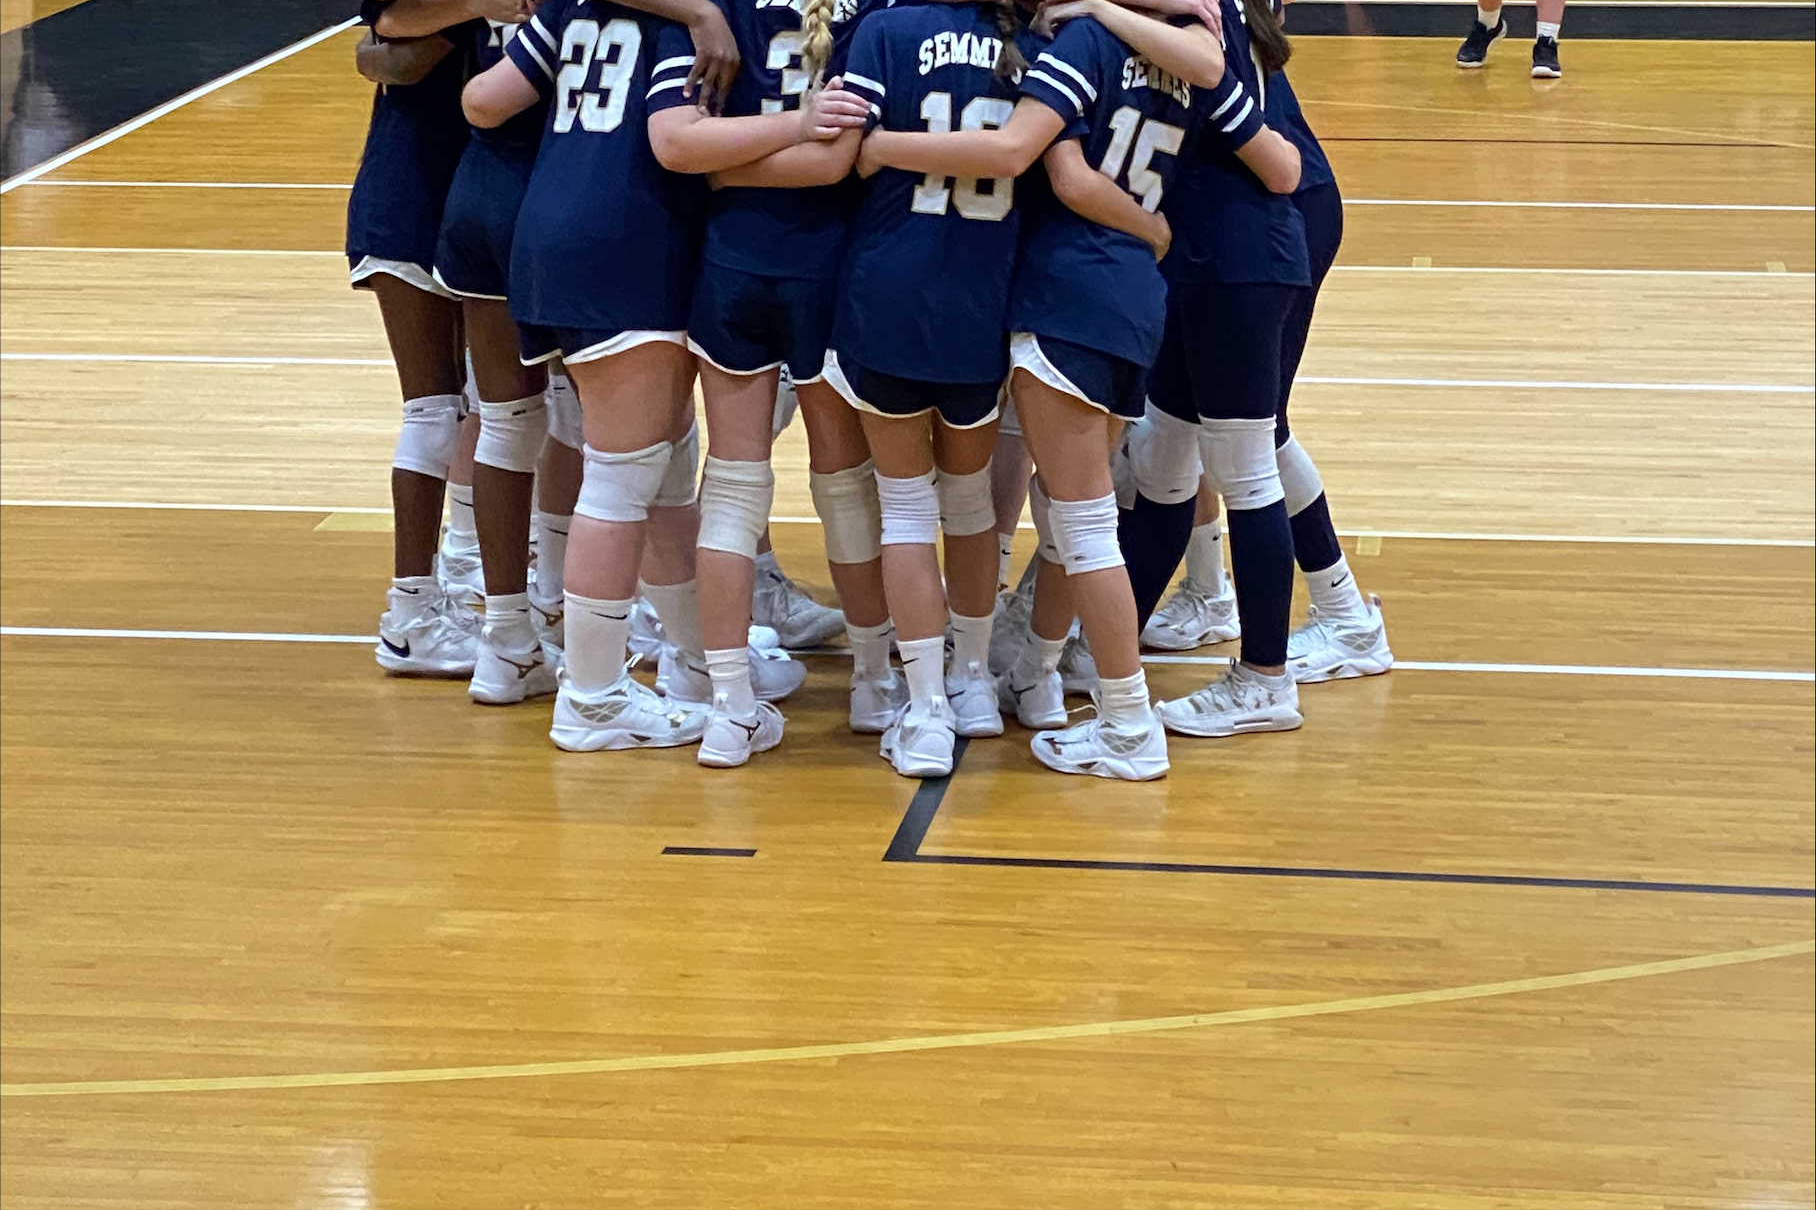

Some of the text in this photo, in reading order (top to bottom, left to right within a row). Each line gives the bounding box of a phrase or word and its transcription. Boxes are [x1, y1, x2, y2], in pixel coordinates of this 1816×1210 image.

[553, 18, 642, 133] 23
[919, 31, 1014, 81] SEMM
[1099, 105, 1186, 214] 15
